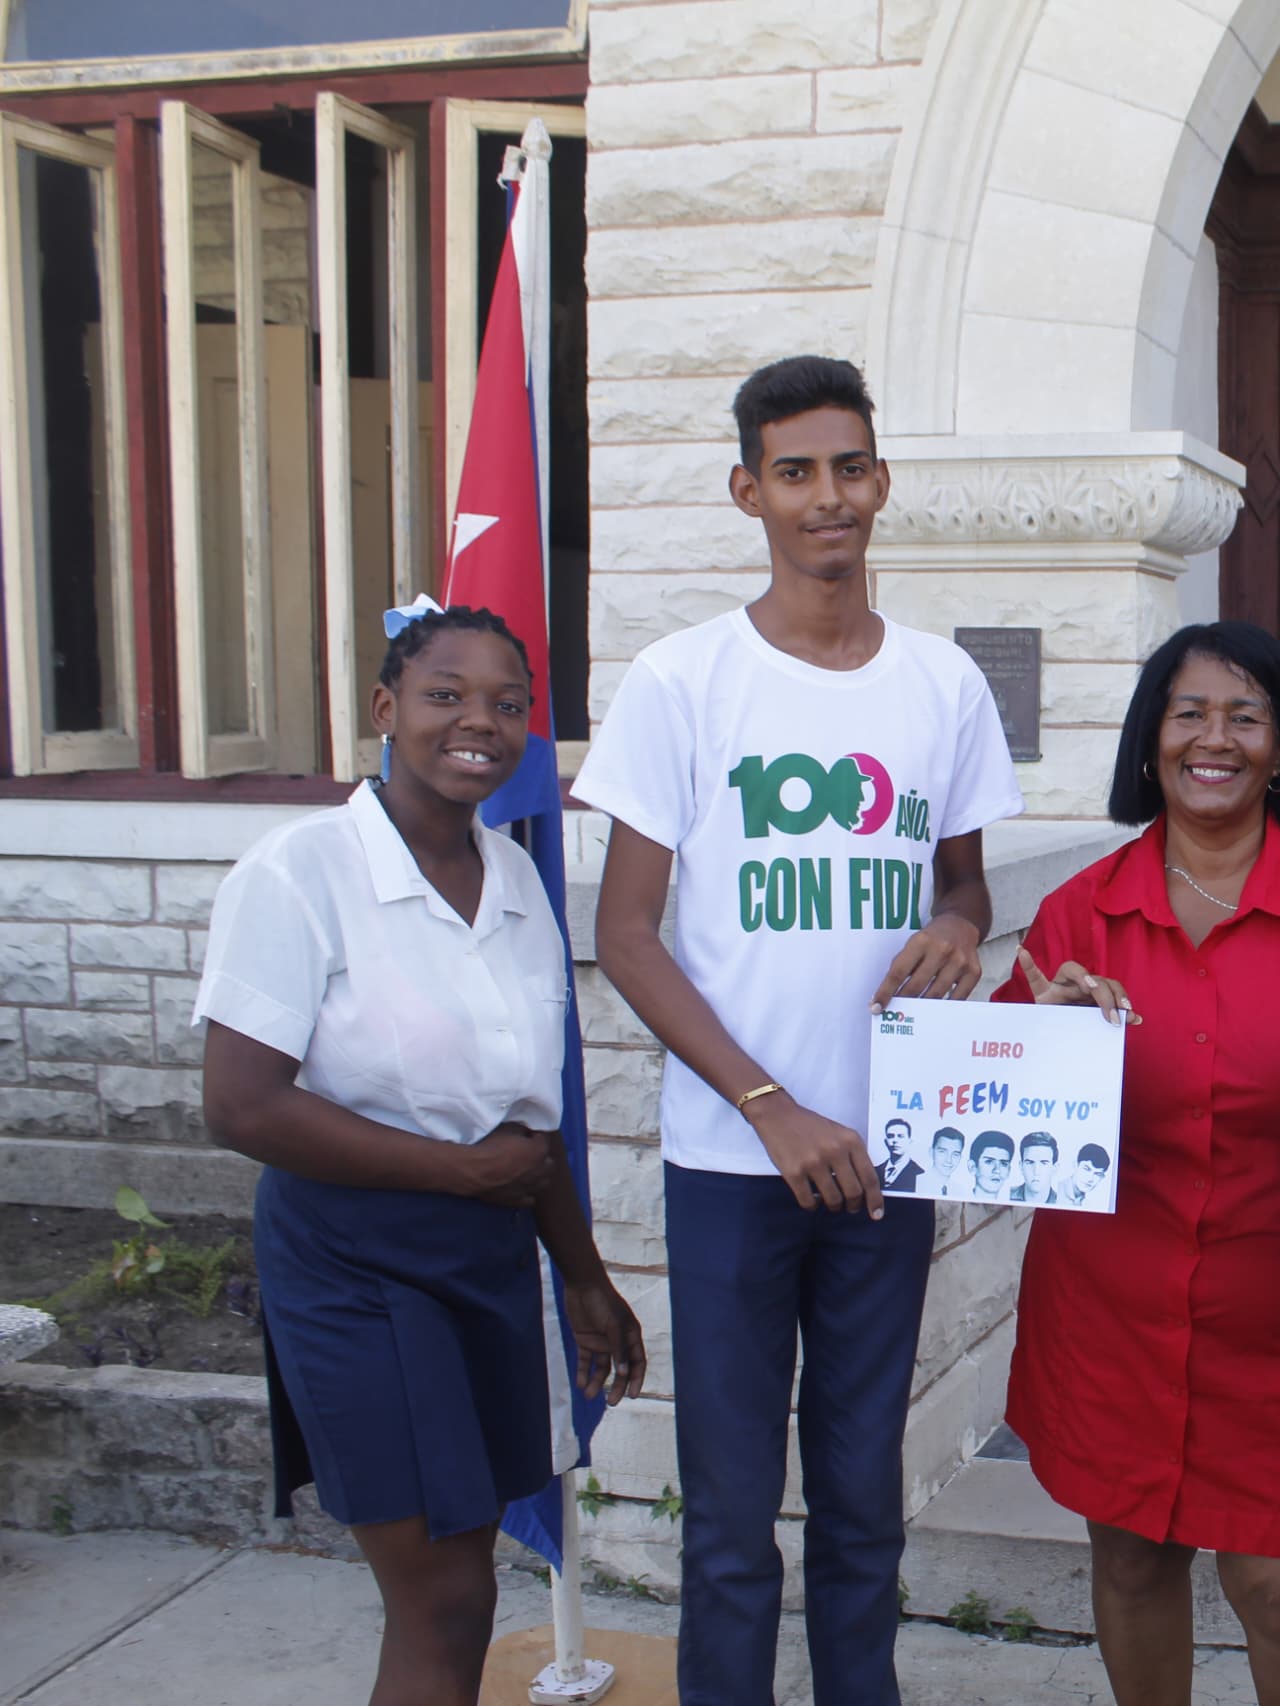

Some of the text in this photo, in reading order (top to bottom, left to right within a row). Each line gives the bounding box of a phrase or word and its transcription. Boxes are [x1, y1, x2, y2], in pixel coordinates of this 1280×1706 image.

[728, 752, 931, 843] 100 AÑO
[738, 857, 833, 933] CON
[880, 1009, 905, 1022] 100
[880, 1023, 914, 1036] CON FIDEL
[971, 1040, 1024, 1059] LIBRO
[890, 1080, 1099, 1120] "LA FEEM SOY YO"
